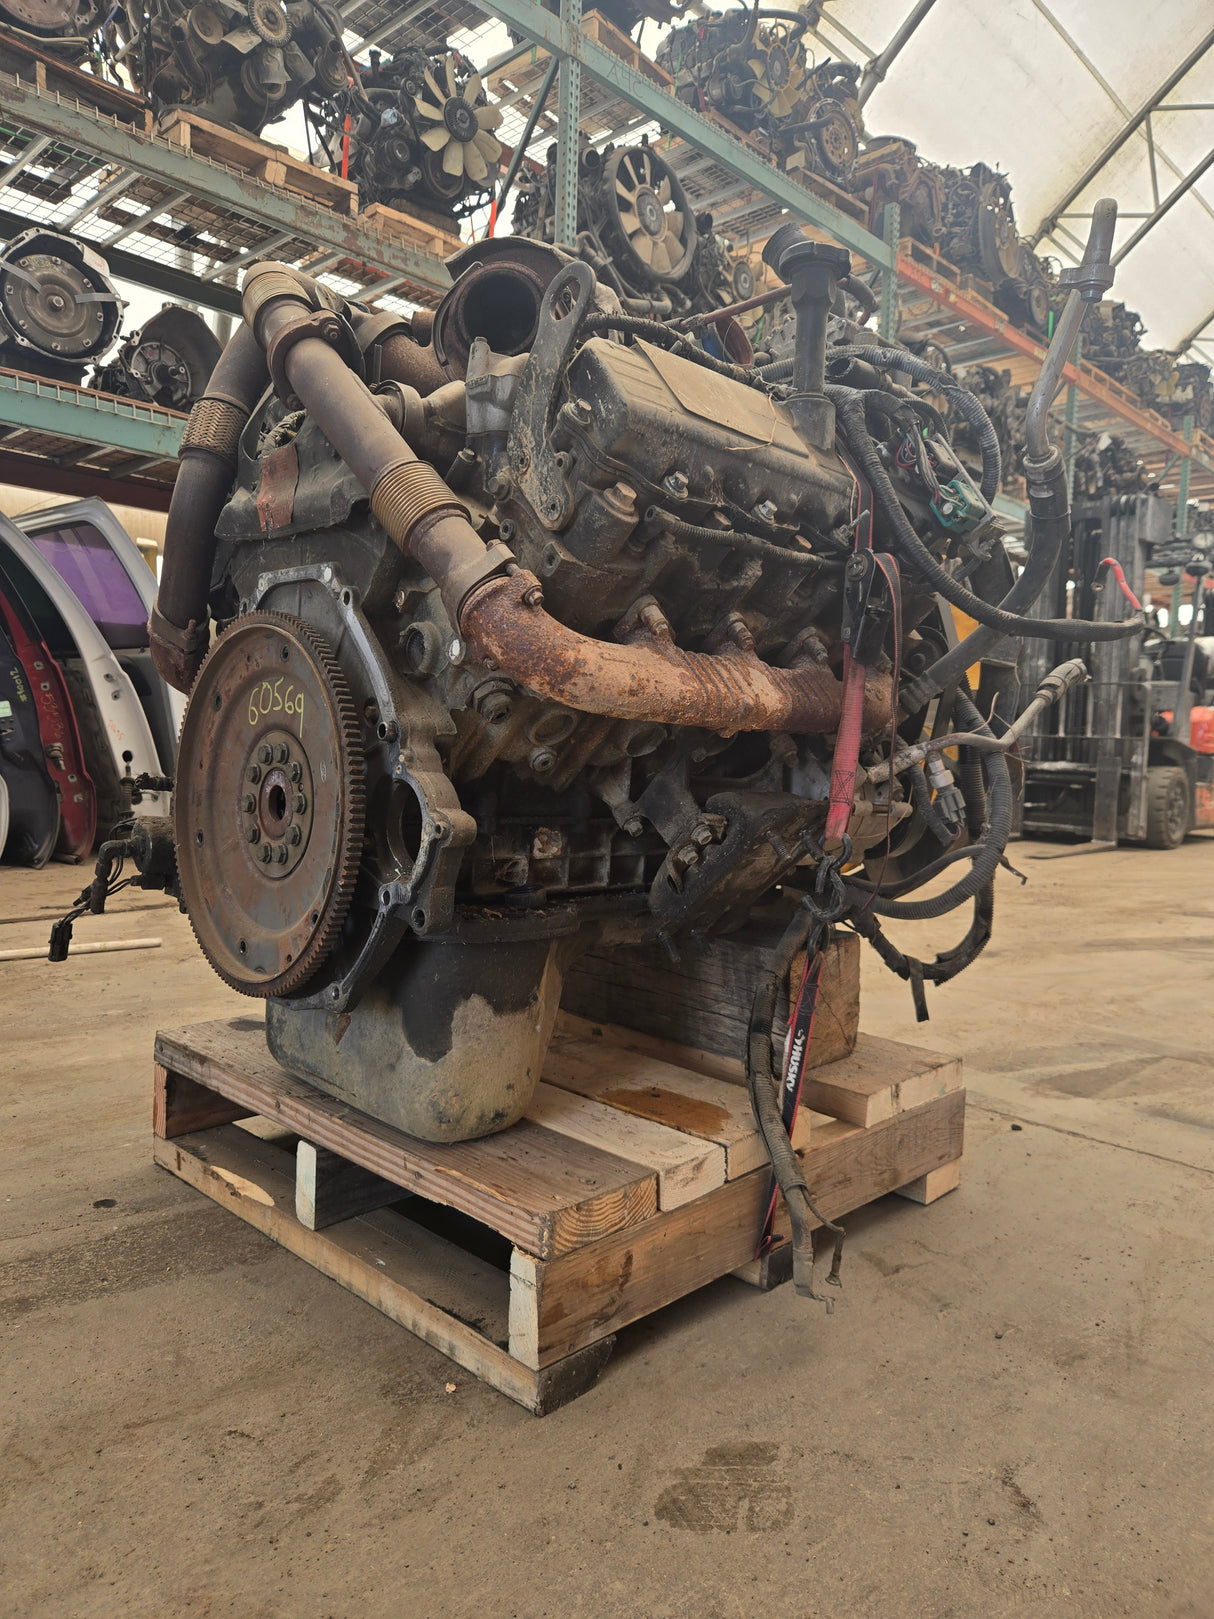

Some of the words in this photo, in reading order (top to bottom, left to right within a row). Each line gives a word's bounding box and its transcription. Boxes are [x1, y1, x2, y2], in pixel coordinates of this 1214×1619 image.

[606, 62, 644, 99] A4C
[248, 676, 305, 739] 60569
[786, 1044, 803, 1093] HUSKY
